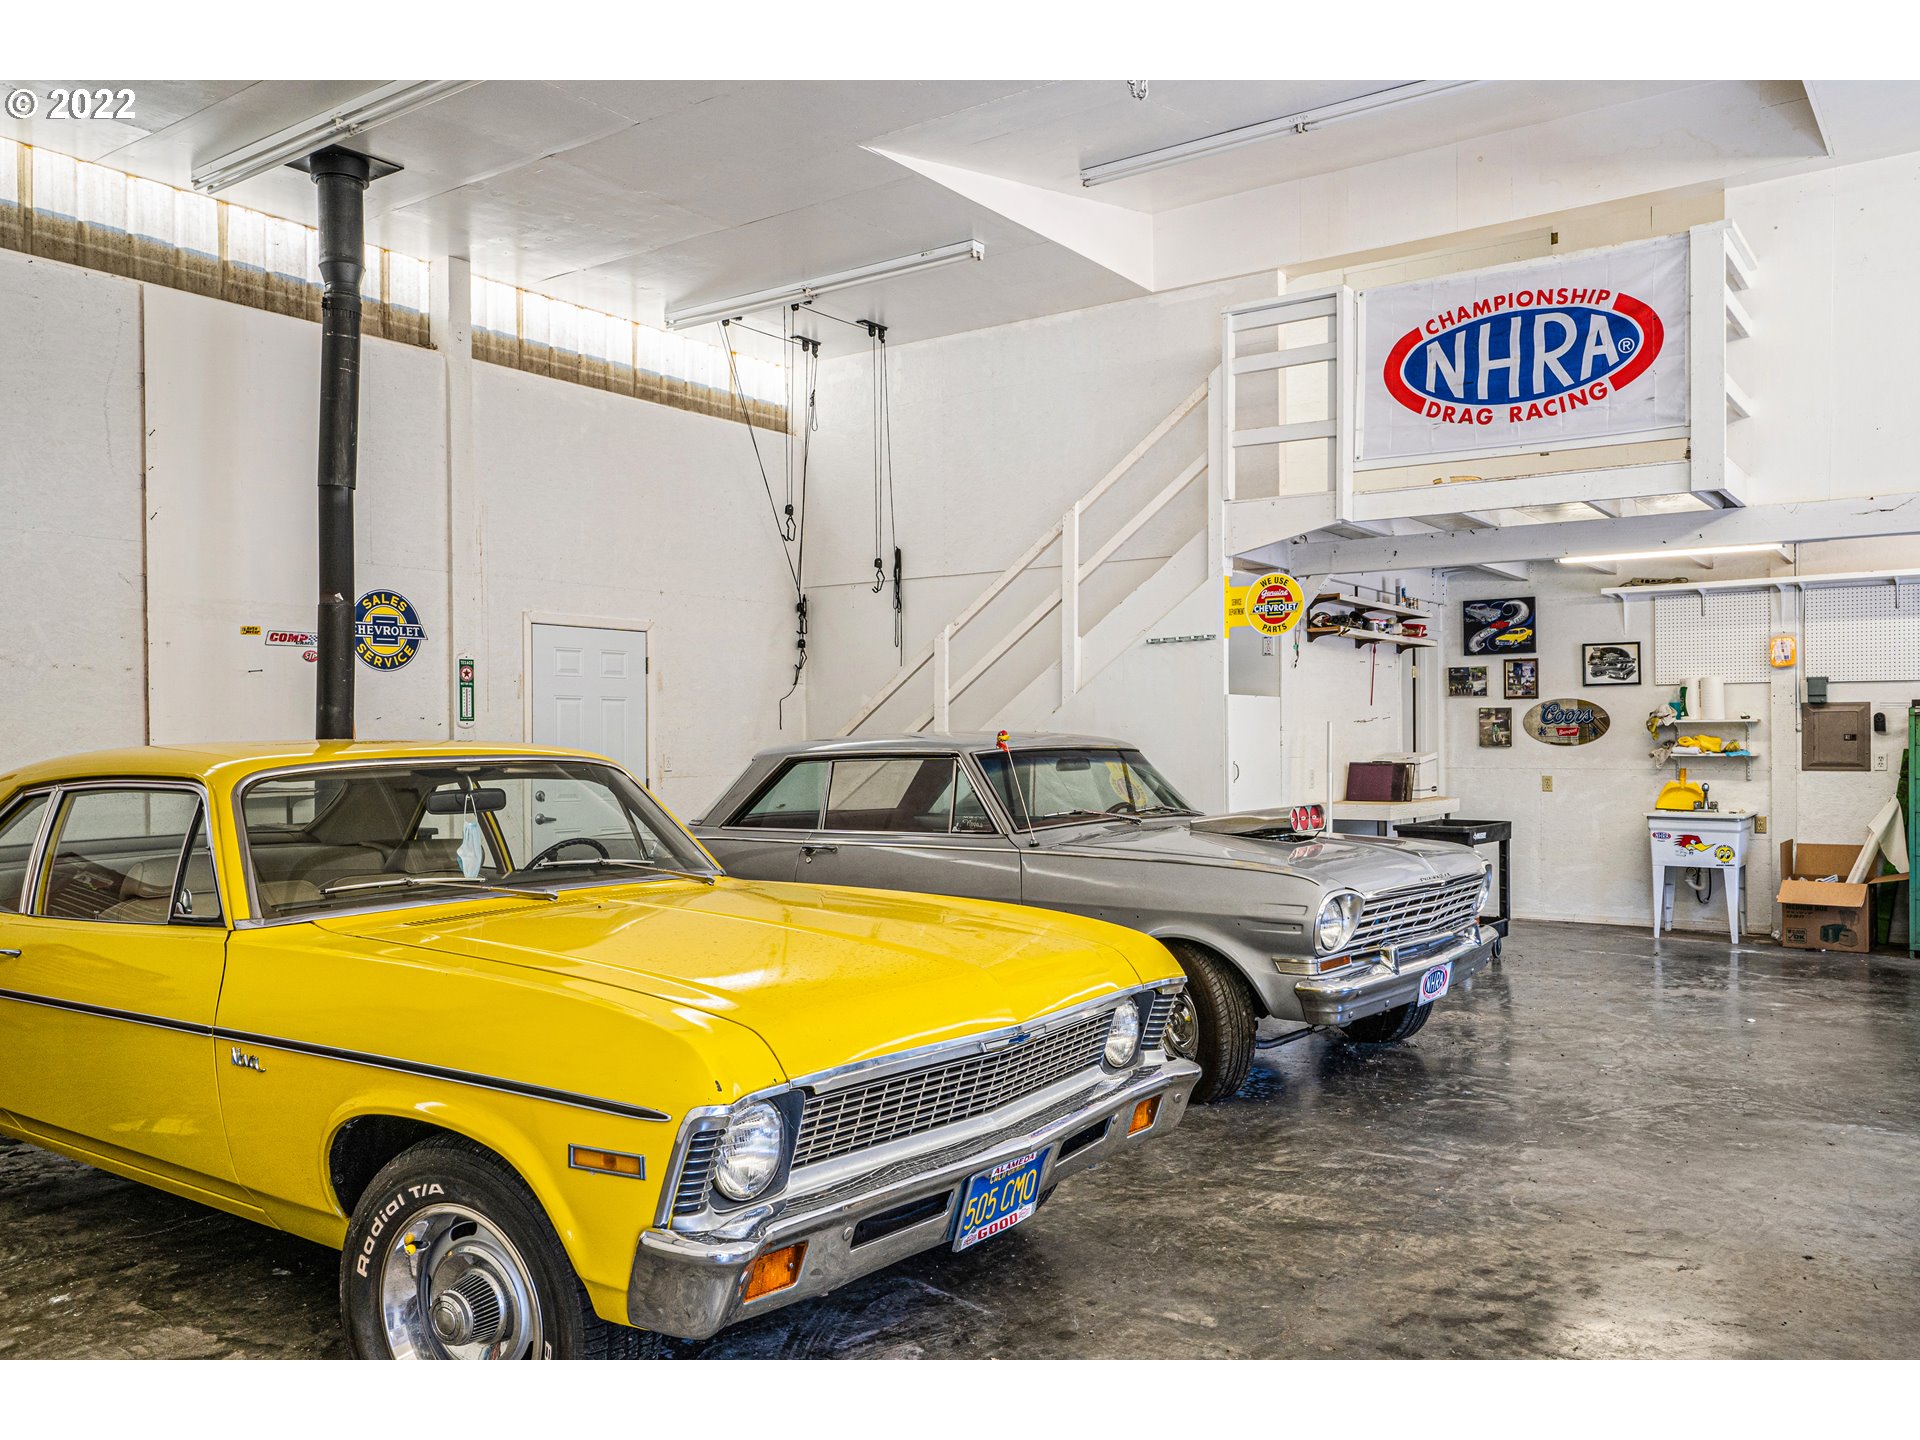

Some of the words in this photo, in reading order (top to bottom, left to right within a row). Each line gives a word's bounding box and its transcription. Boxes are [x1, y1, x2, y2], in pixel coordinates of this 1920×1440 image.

[1425, 287, 1611, 335] CHAMPIONSHIP
[1425, 312, 1620, 400] NHRA
[1426, 399, 1493, 426] DRAG
[1509, 381, 1608, 423] RACING
[1260, 577, 1273, 588] WE
[1274, 576, 1289, 587] USE
[362, 593, 408, 612] SALES
[1261, 589, 1289, 600] Genuine
[1253, 602, 1298, 613] CHEVROLET
[269, 632, 309, 643] COMP
[1262, 622, 1287, 633] PARTS
[357, 643, 414, 668] SERVICE
[1541, 703, 1594, 725] Coors
[1426, 971, 1444, 992] NHRA
[231, 1046, 267, 1073] Nova
[994, 1153, 1035, 1175] ALAMEDA
[963, 1187, 999, 1231] 505
[1000, 1169, 1037, 1211] CMO
[356, 1193, 405, 1278] Radial
[408, 1183, 445, 1199] T/A
[977, 1213, 1018, 1239] GOOD
